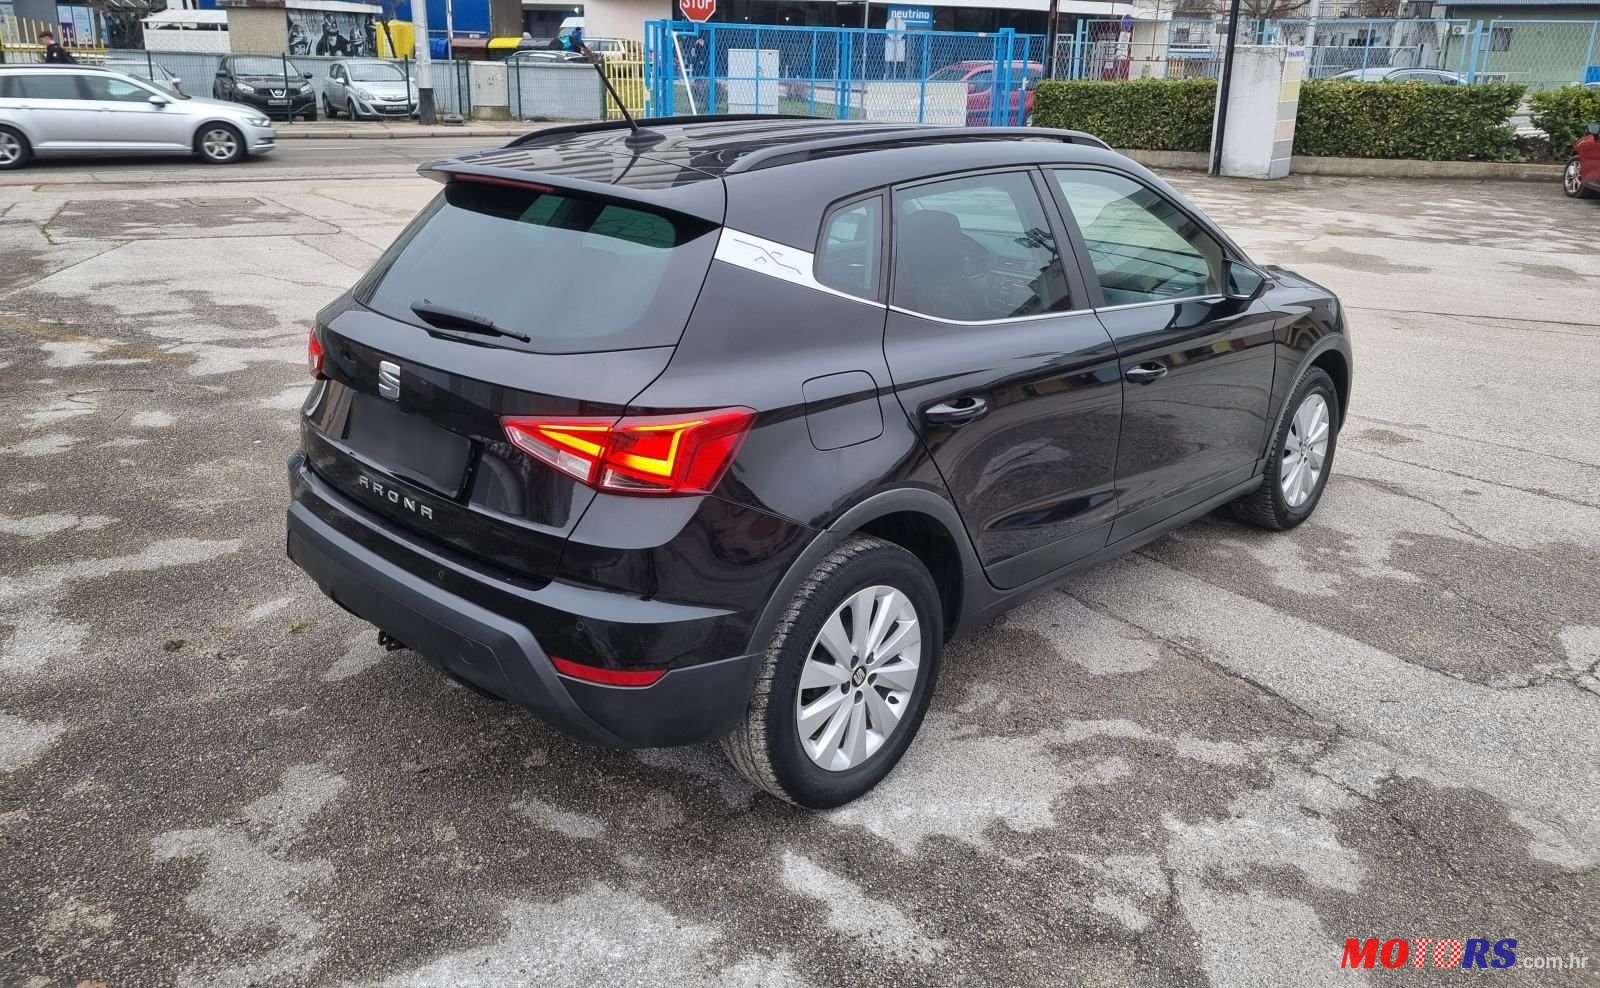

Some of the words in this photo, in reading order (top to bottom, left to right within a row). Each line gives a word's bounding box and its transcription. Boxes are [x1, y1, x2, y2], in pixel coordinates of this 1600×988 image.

[683, 0, 712, 9] STOP
[891, 8, 930, 20] neutrino
[359, 475, 433, 520] ARONA
